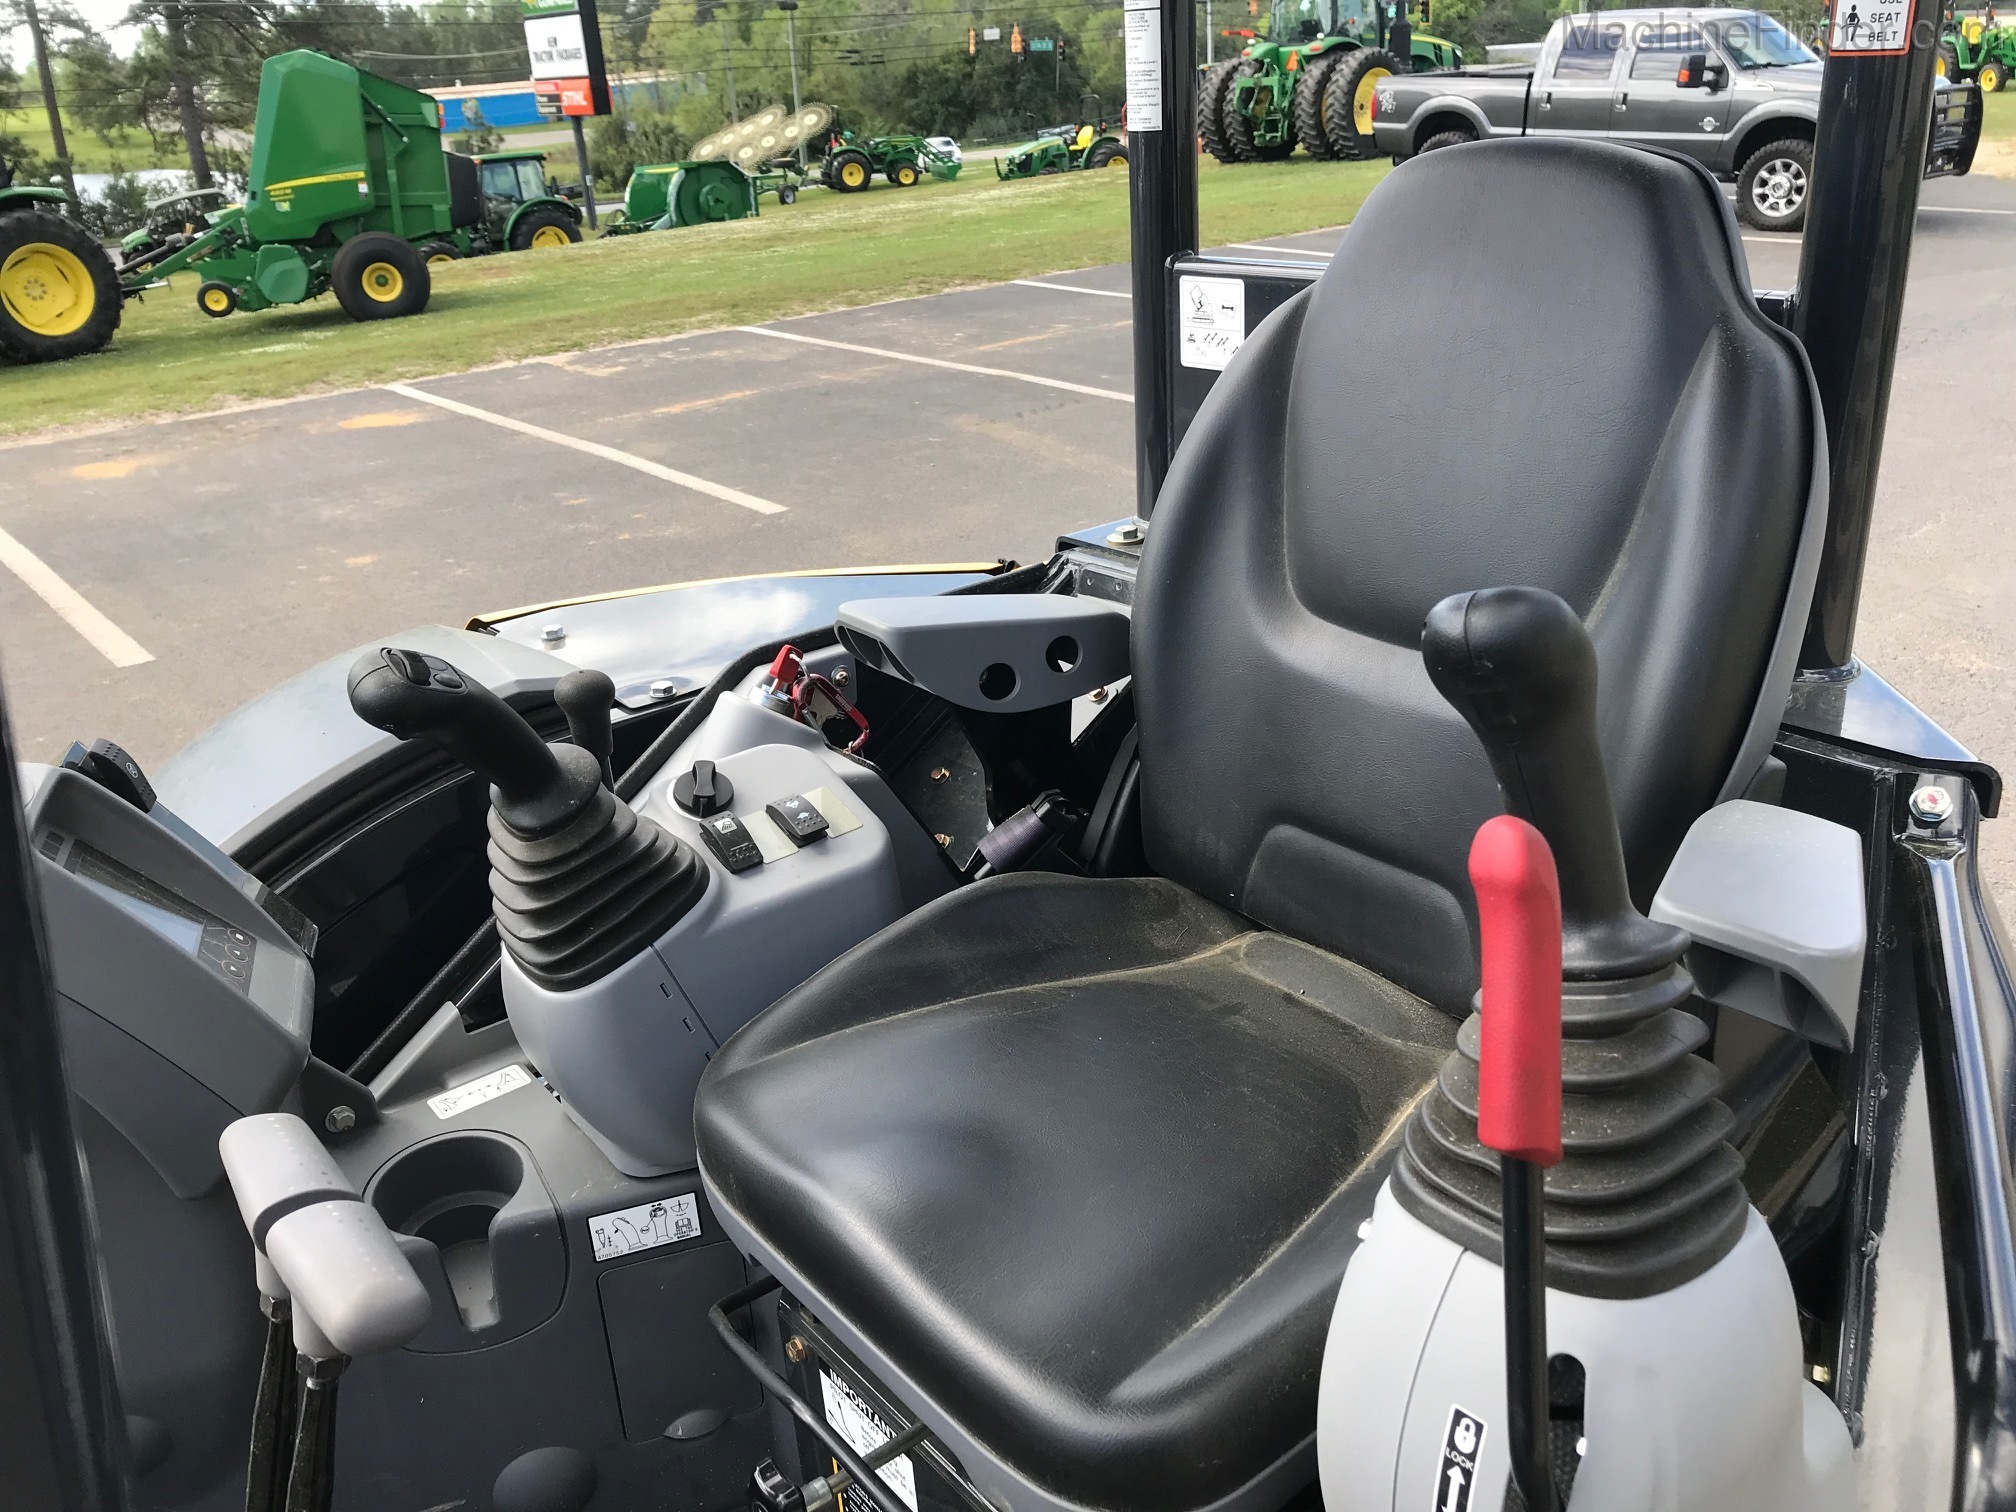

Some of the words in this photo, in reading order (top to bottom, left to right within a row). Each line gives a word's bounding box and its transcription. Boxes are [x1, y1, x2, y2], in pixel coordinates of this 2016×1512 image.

[1869, 12, 1901, 24] SEAT
[1868, 31, 1898, 42] BELT
[829, 1368, 898, 1439] IMPORTANT
[1445, 1446, 1474, 1472] LOCK
